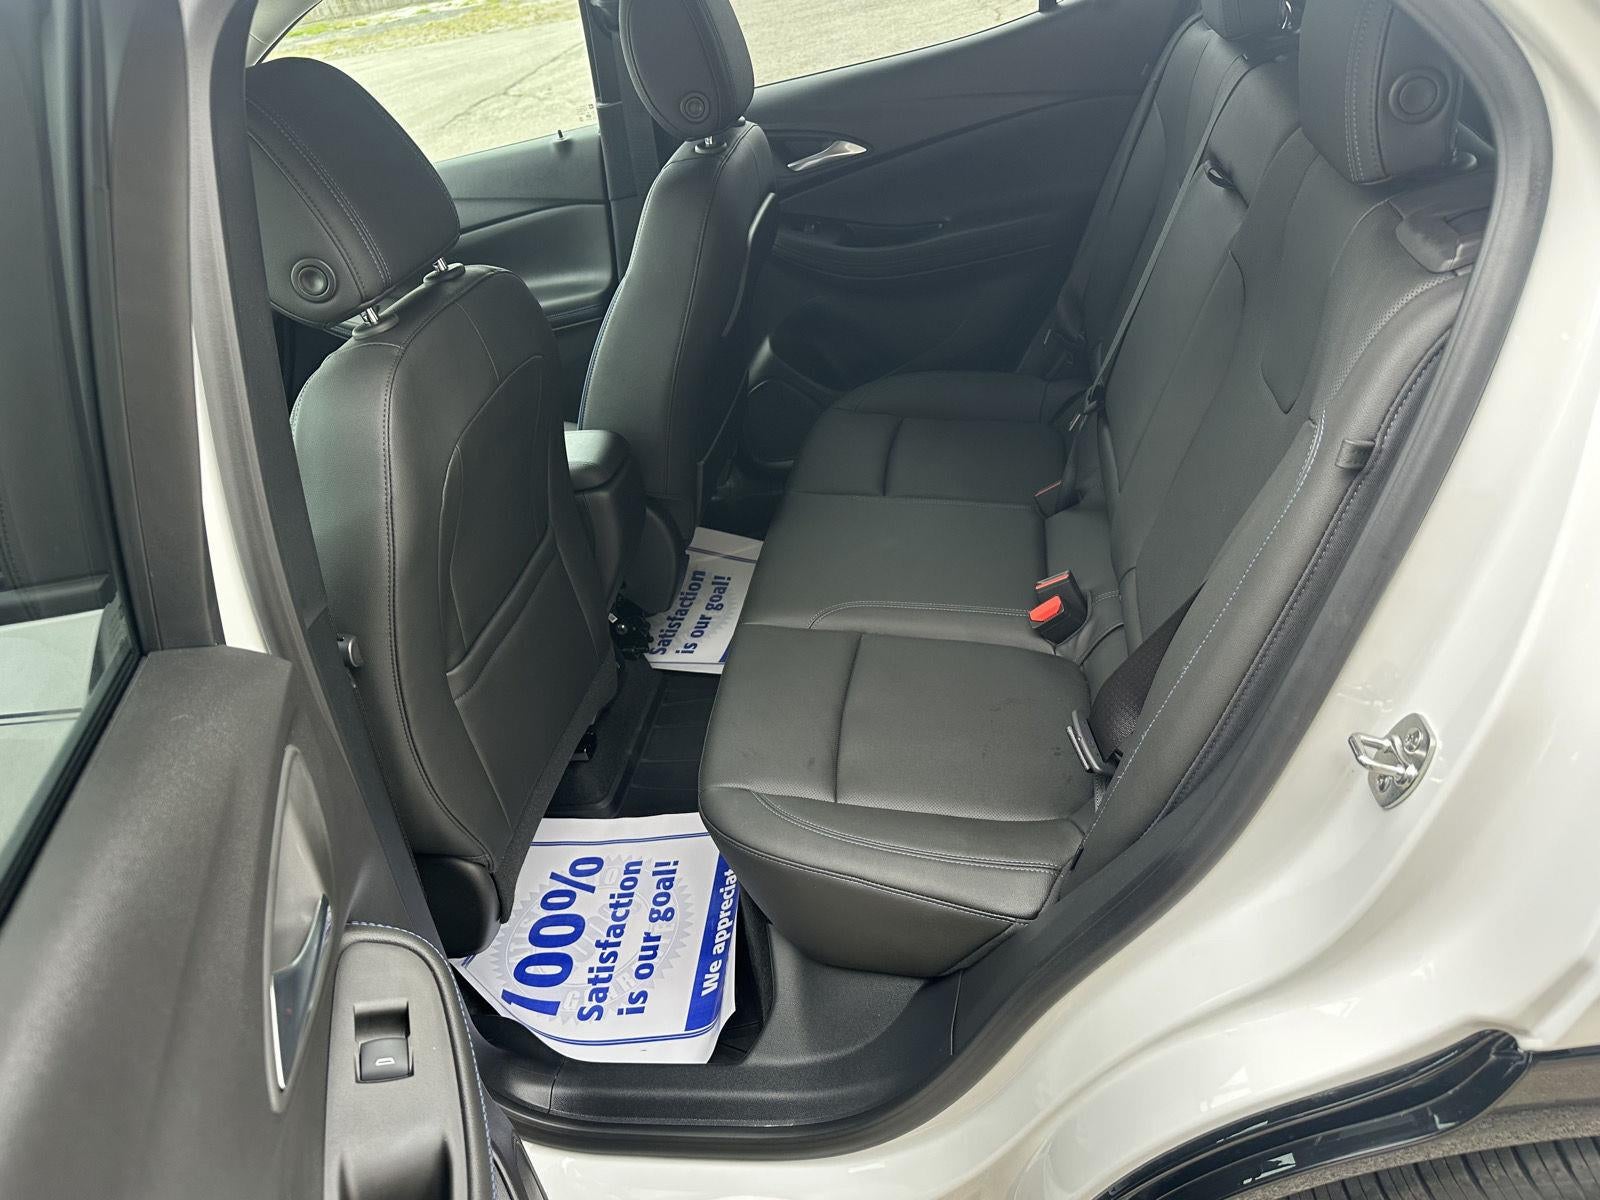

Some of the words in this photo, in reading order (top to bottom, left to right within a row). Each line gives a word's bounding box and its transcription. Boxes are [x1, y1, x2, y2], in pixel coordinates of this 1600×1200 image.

[651, 570, 706, 655] Satisfaction
[675, 643, 698, 654] is
[690, 614, 712, 639] our
[705, 575, 731, 611] goal!
[501, 856, 604, 1016] 100%
[577, 860, 643, 1021] Satisfaction
[617, 990, 648, 1016] is
[634, 932, 662, 980] our
[648, 859, 679, 923] goal!
[700, 959, 723, 997] We
